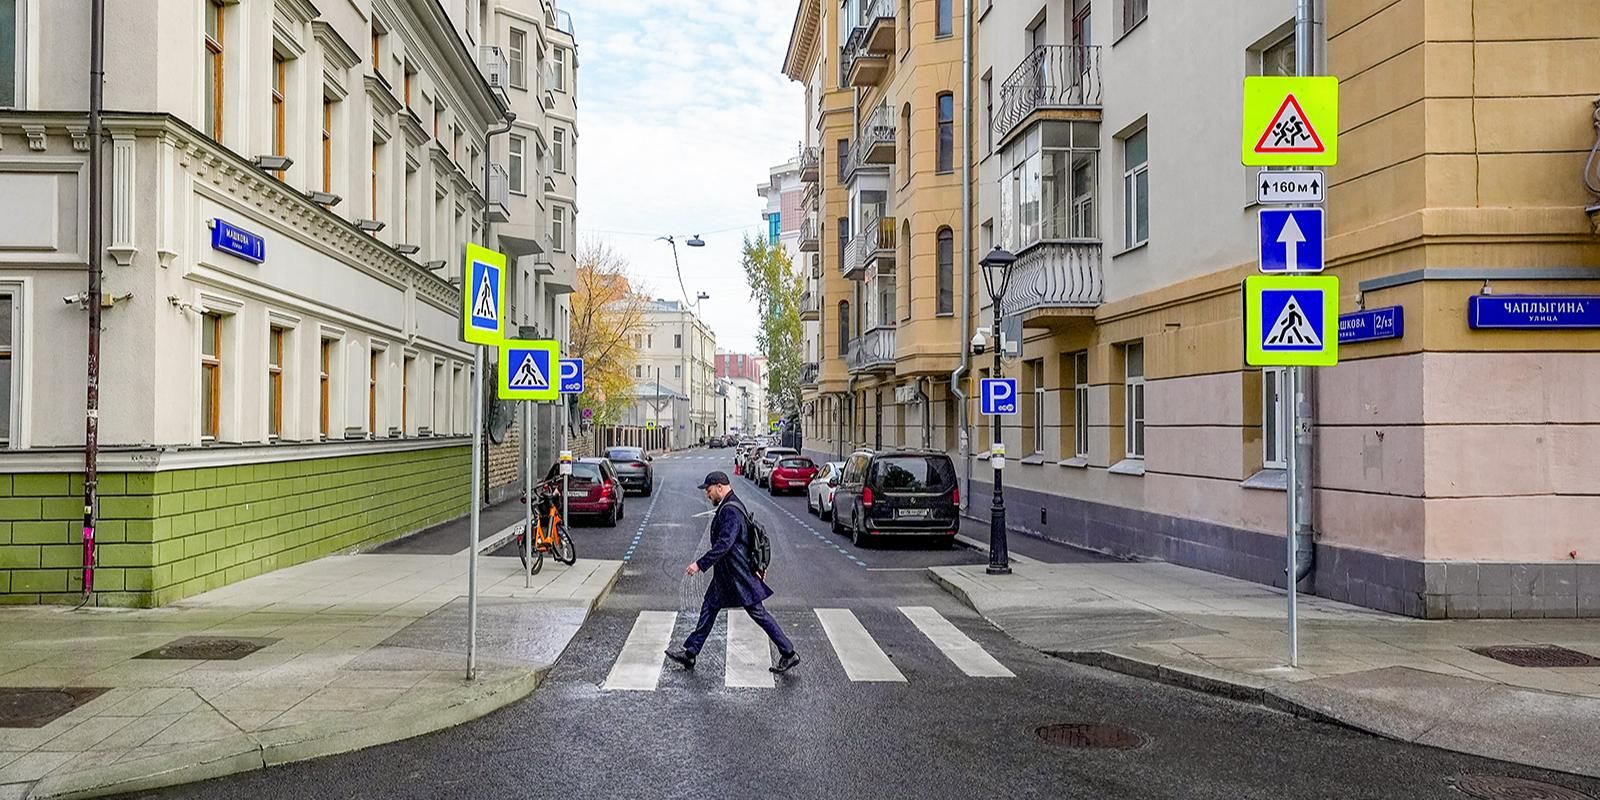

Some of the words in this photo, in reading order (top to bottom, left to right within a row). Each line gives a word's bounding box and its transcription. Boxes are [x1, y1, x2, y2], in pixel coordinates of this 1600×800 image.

[1272, 181, 1295, 193] 160
[226, 227, 249, 246] МАШКОВА
[257, 240, 261, 257] 1
[1503, 302, 1585, 313] ЧАПЛЫГИНА
[1338, 317, 1366, 331] ШКОВА
[558, 361, 579, 391] P
[989, 381, 1012, 412] P
